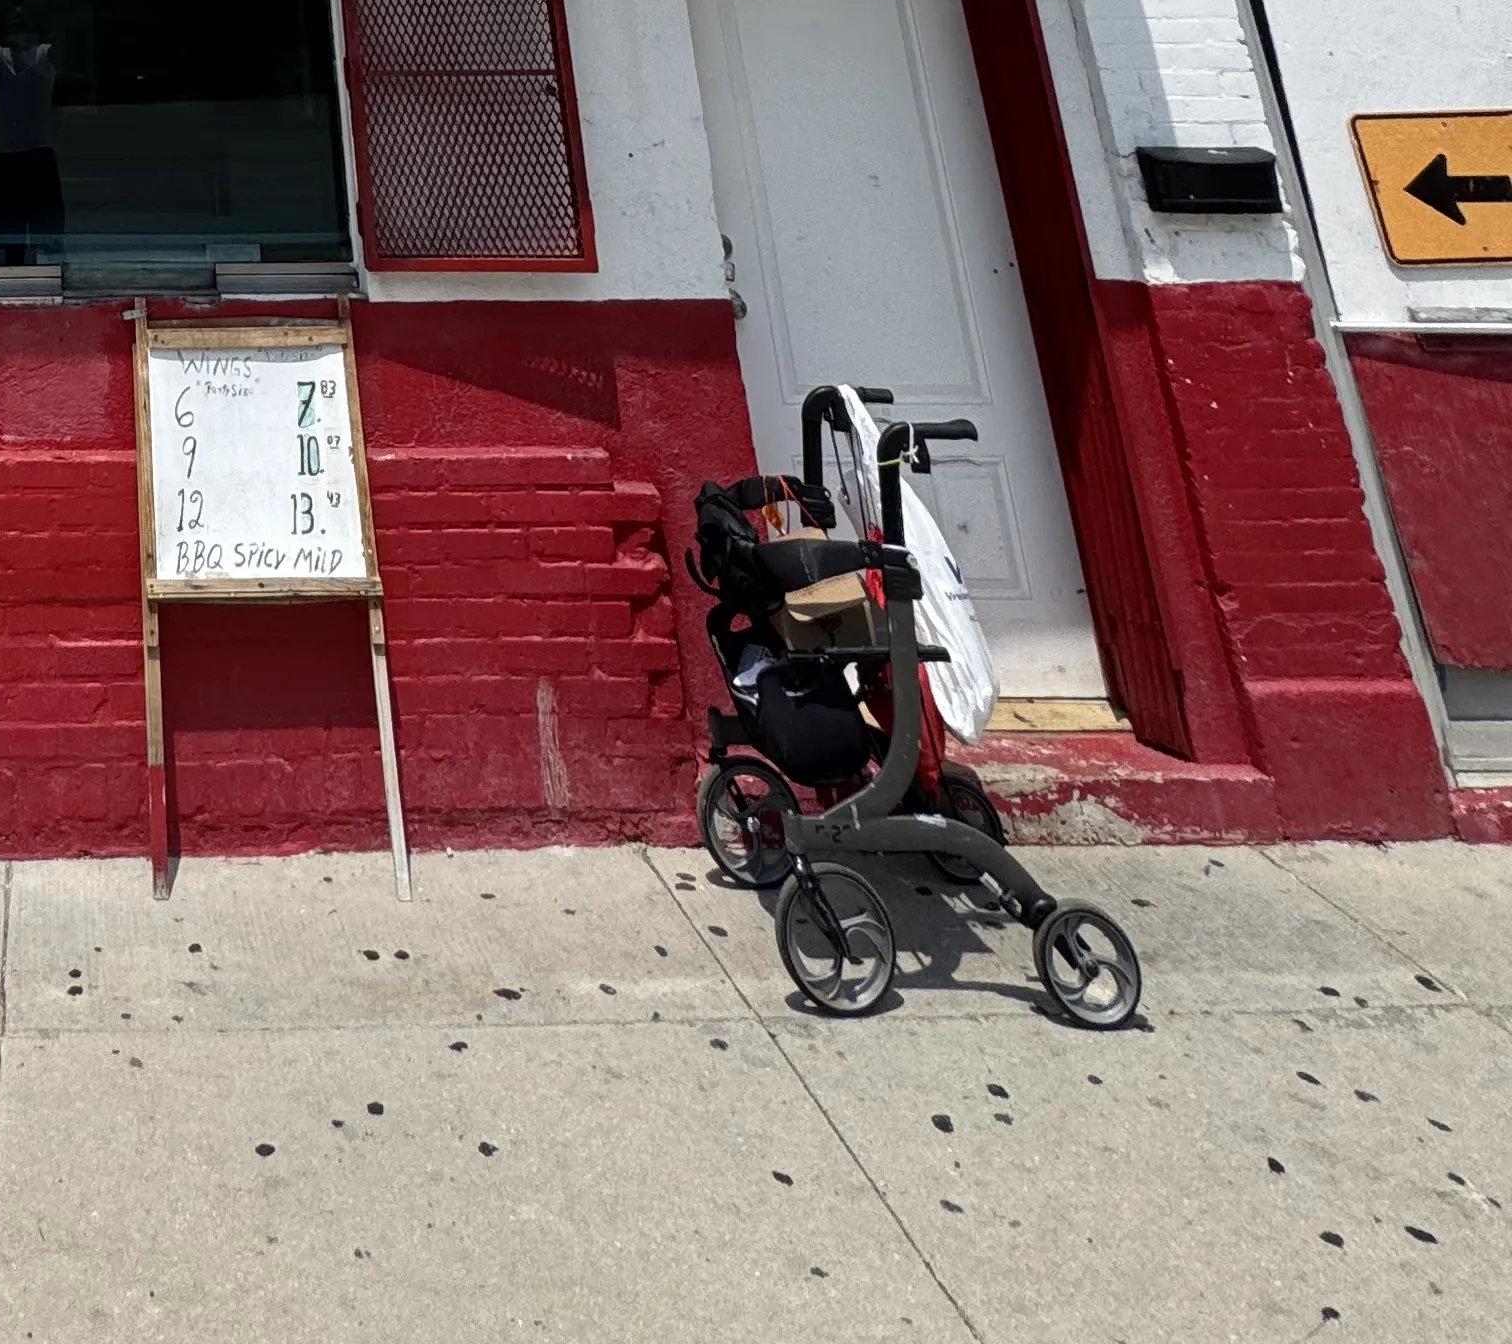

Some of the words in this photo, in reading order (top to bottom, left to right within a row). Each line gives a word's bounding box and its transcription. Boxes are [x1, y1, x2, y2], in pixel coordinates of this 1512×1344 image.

[177, 349, 252, 378] WINGS
[174, 386, 195, 428] 6
[182, 435, 198, 480] 9
[175, 487, 205, 533] 12
[176, 540, 224, 576] BBQ
